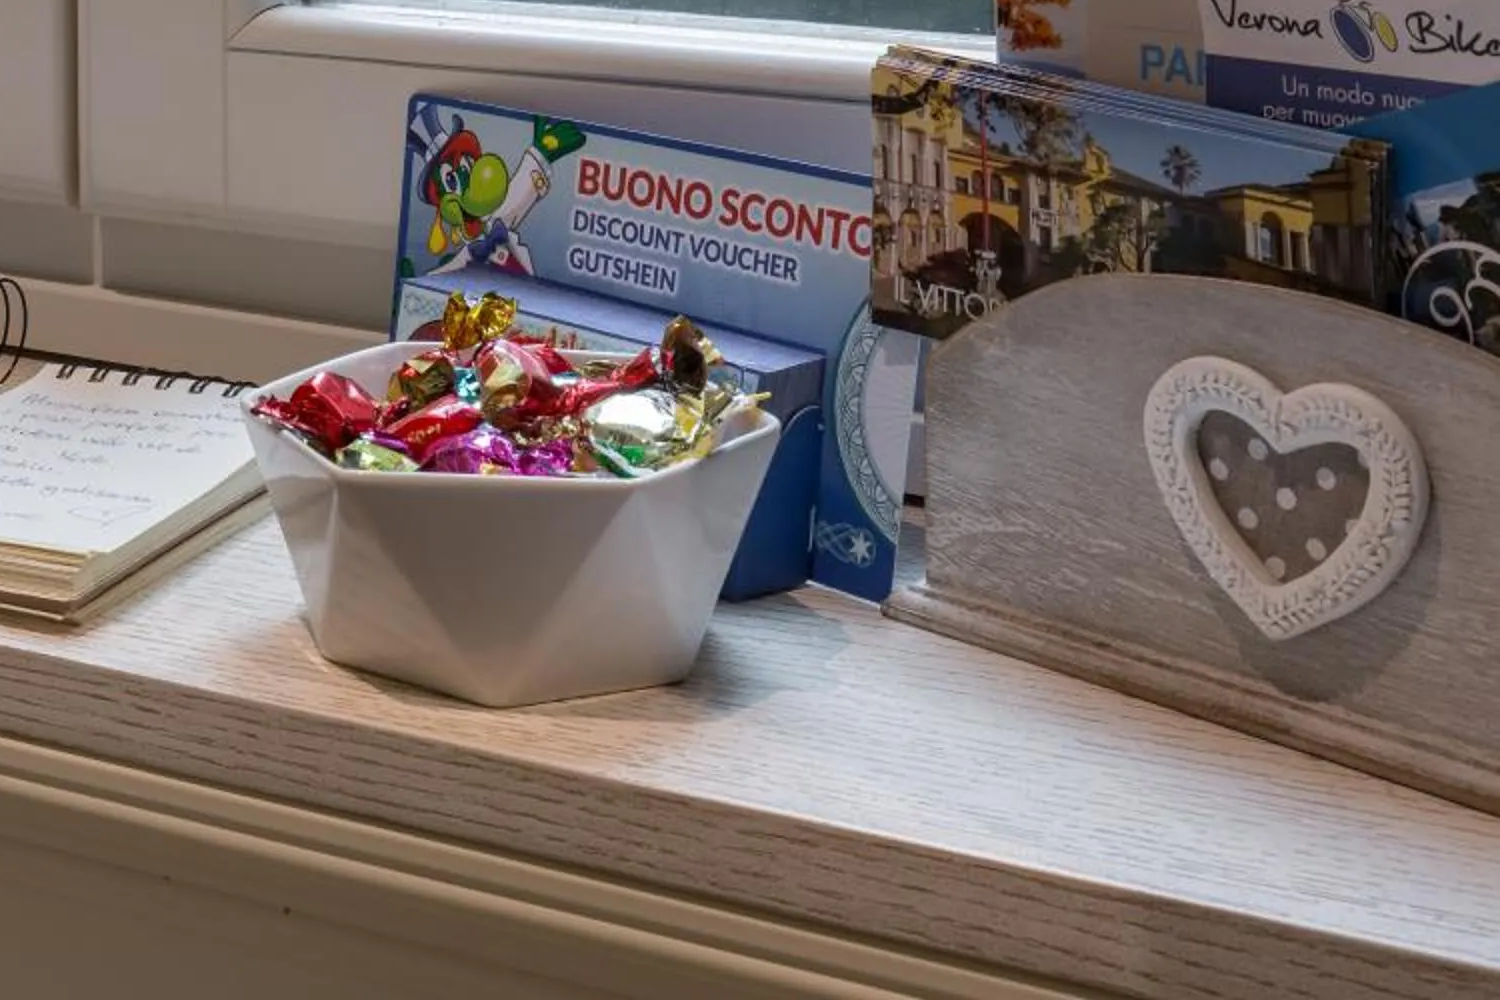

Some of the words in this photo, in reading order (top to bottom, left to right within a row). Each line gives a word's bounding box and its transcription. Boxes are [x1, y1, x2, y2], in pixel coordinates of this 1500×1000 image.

[1281, 74, 1311, 98] Un
[1317, 79, 1375, 106] modo
[1263, 102, 1296, 124] per
[577, 157, 713, 220] BUONO
[572, 208, 686, 255] DISCOUNT
[688, 233, 799, 283] VOUCHER
[569, 247, 677, 293] GUTSHEIN
[893, 274, 912, 305] IL
